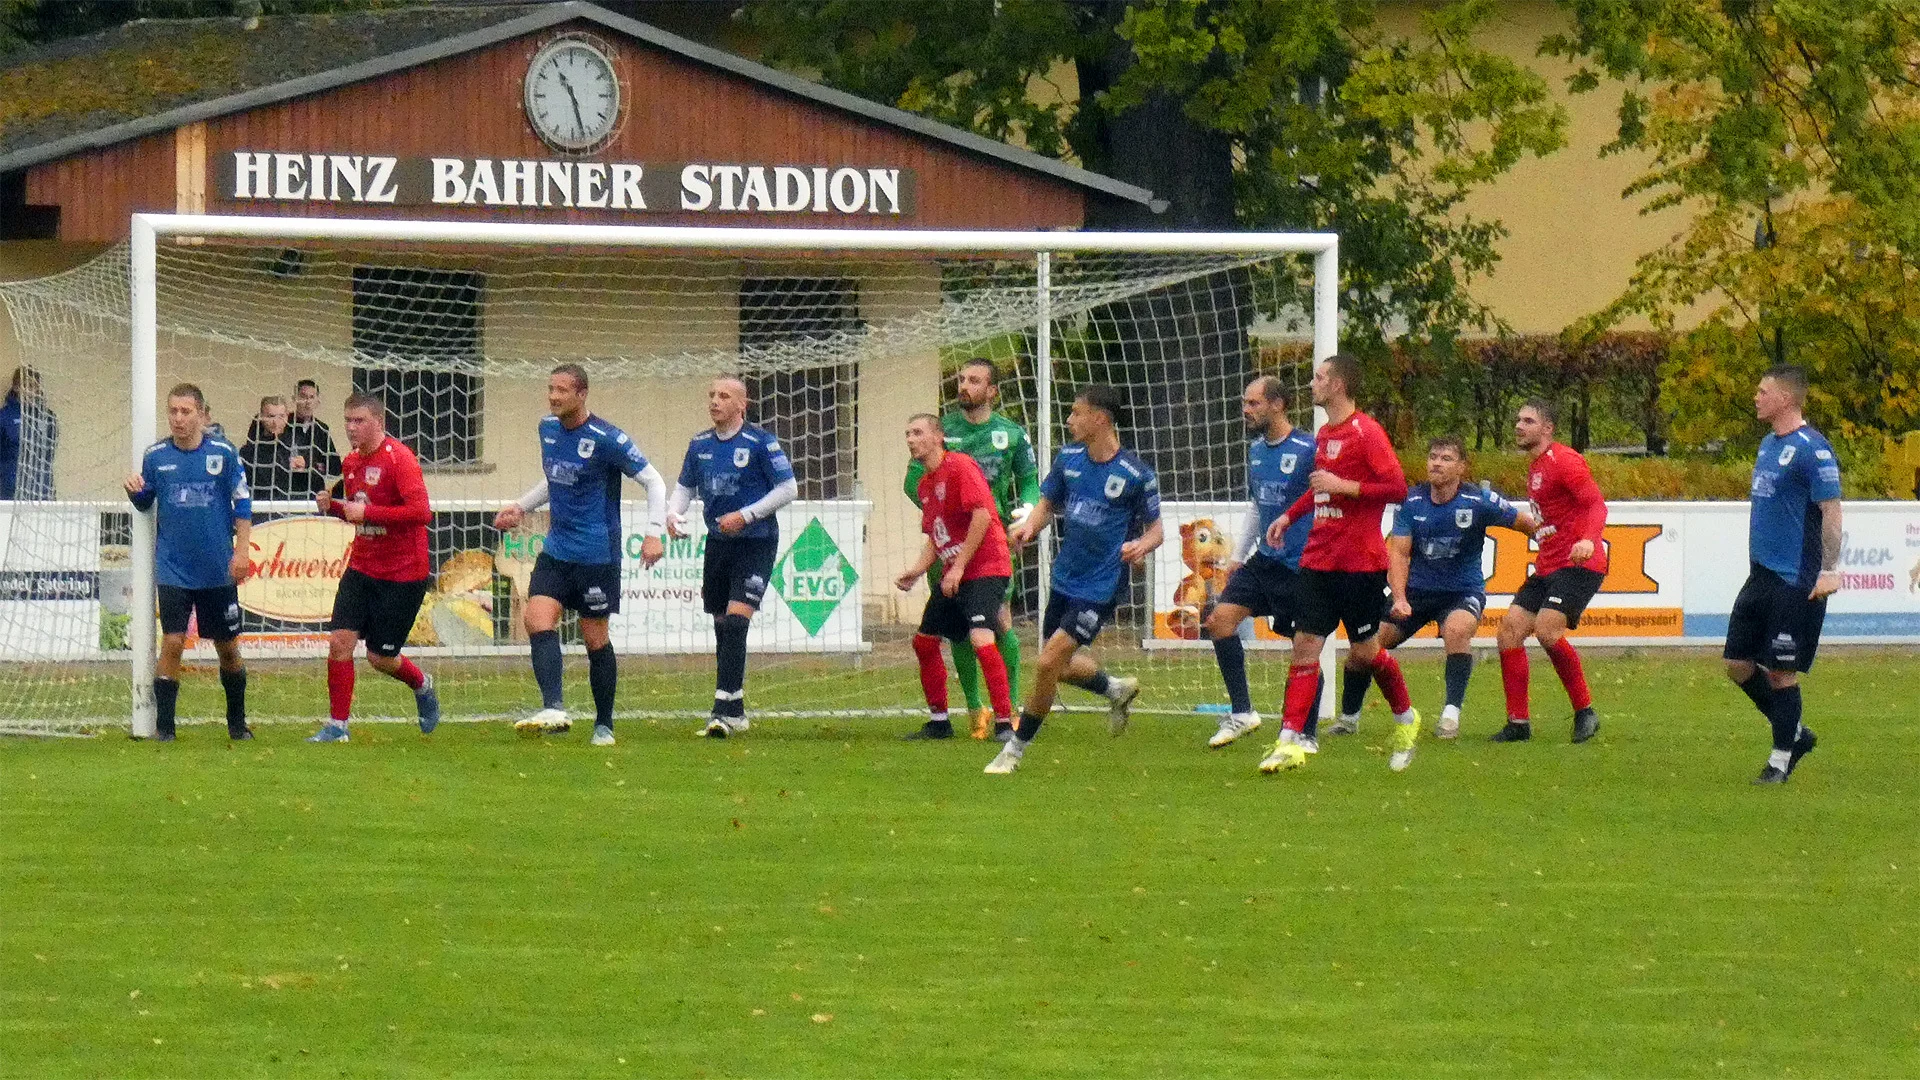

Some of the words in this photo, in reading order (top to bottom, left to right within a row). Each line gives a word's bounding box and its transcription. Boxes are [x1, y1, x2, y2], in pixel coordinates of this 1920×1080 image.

[233, 151, 398, 204] HEINZ
[431, 158, 647, 211] BAHNER
[679, 164, 902, 215] STADION
[793, 576, 838, 597] EVG
